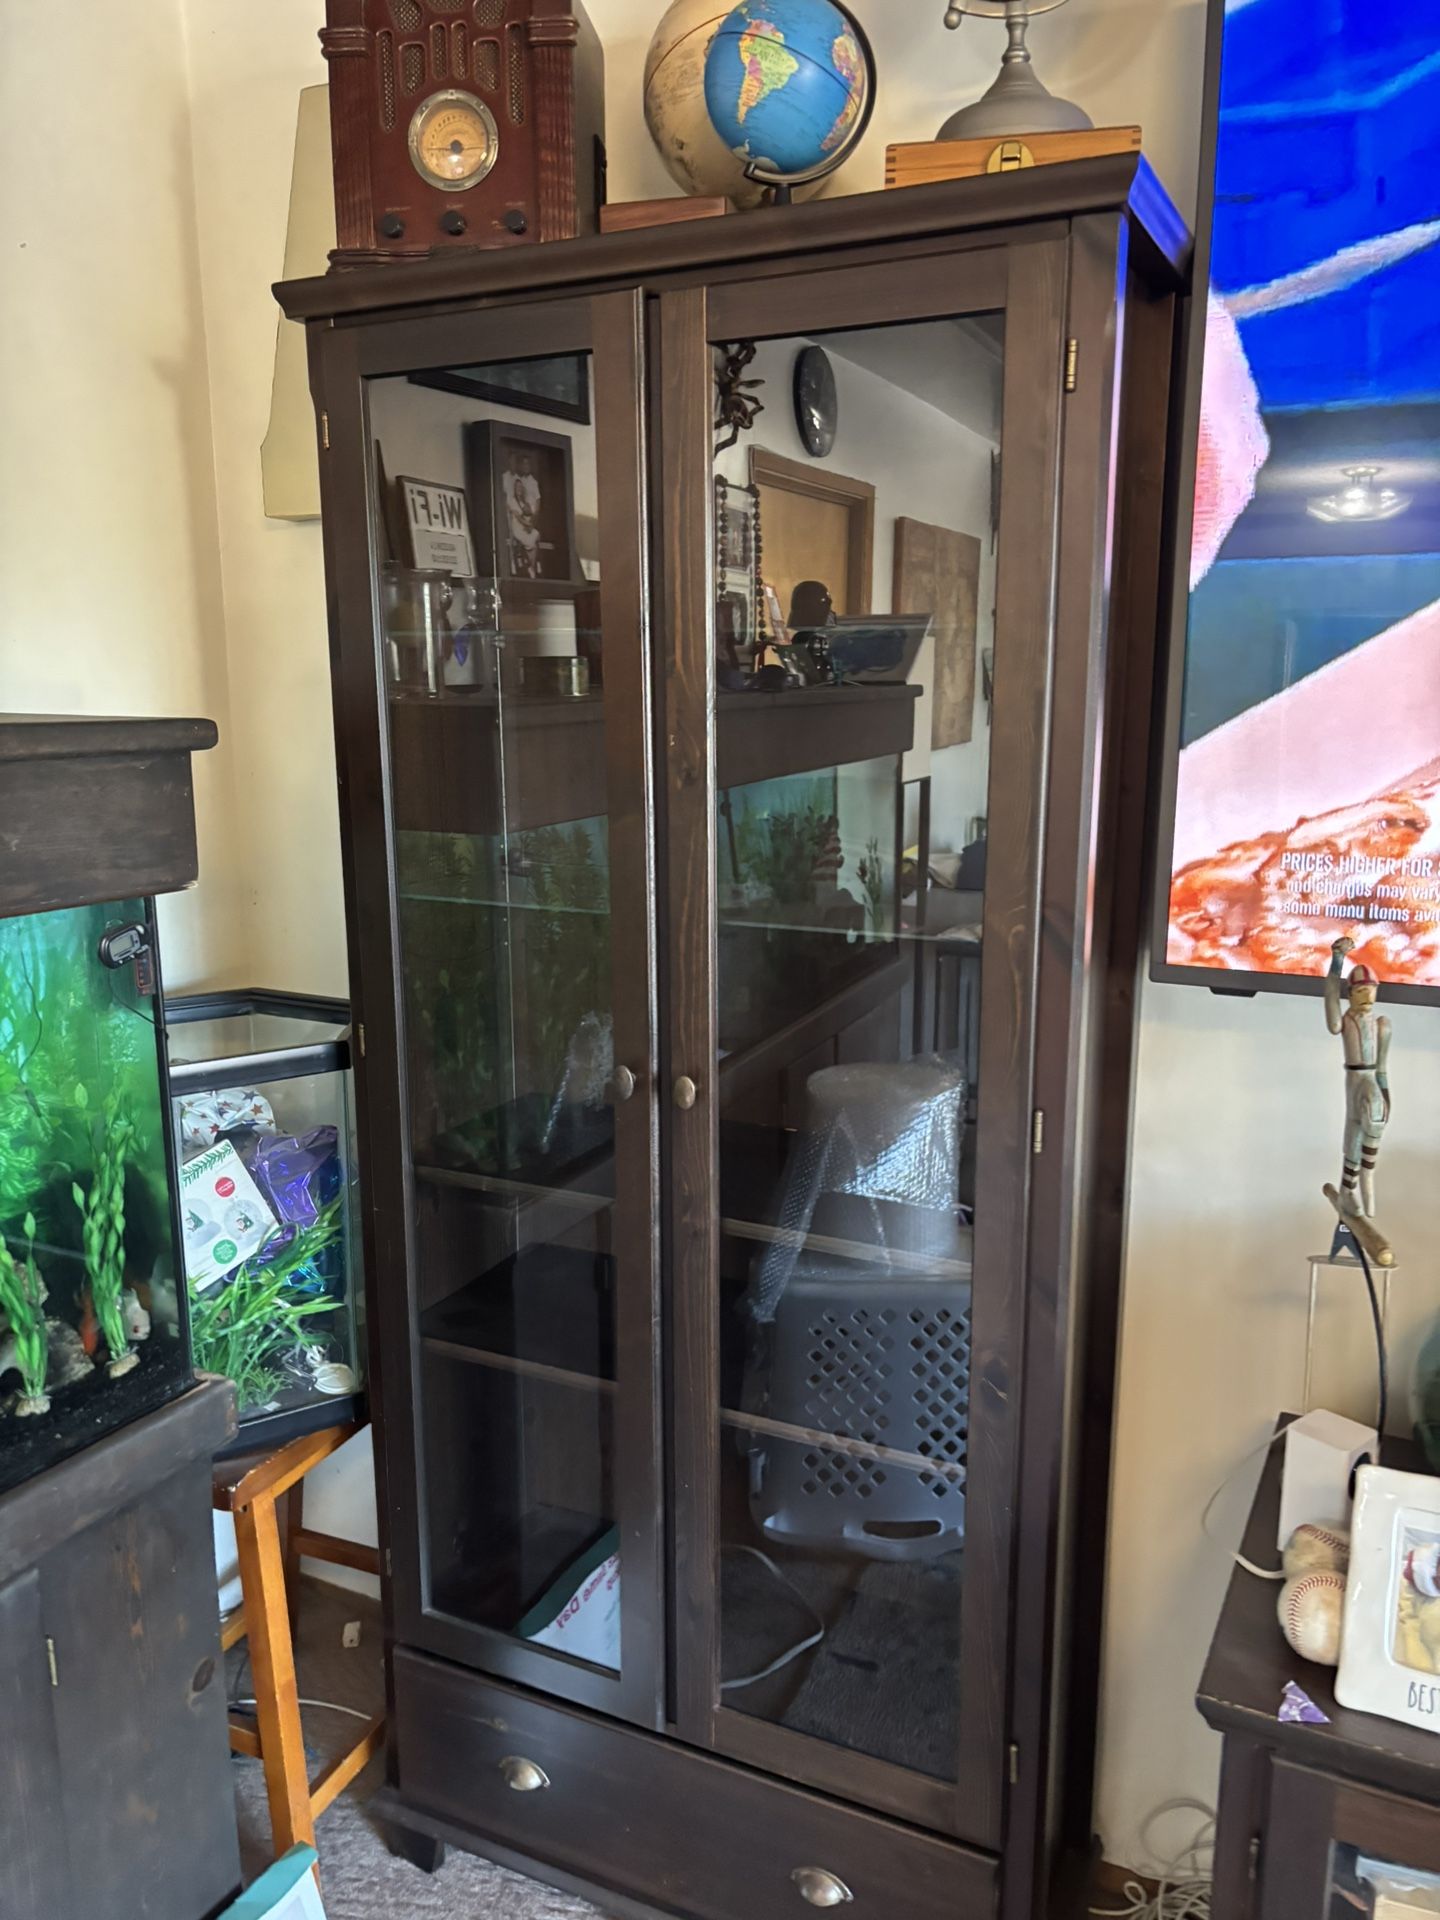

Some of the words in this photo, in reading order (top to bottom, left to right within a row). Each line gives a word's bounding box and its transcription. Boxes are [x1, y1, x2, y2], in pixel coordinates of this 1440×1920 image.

[1280, 852, 1334, 875] PRICES
[1338, 854, 1396, 875] HIGHER
[1401, 857, 1433, 877] FOR
[1376, 884, 1408, 902] may
[1284, 900, 1321, 916] some
[1324, 903, 1366, 919] menu
[1368, 902, 1410, 922] items
[1407, 1681, 1440, 1714] BES
